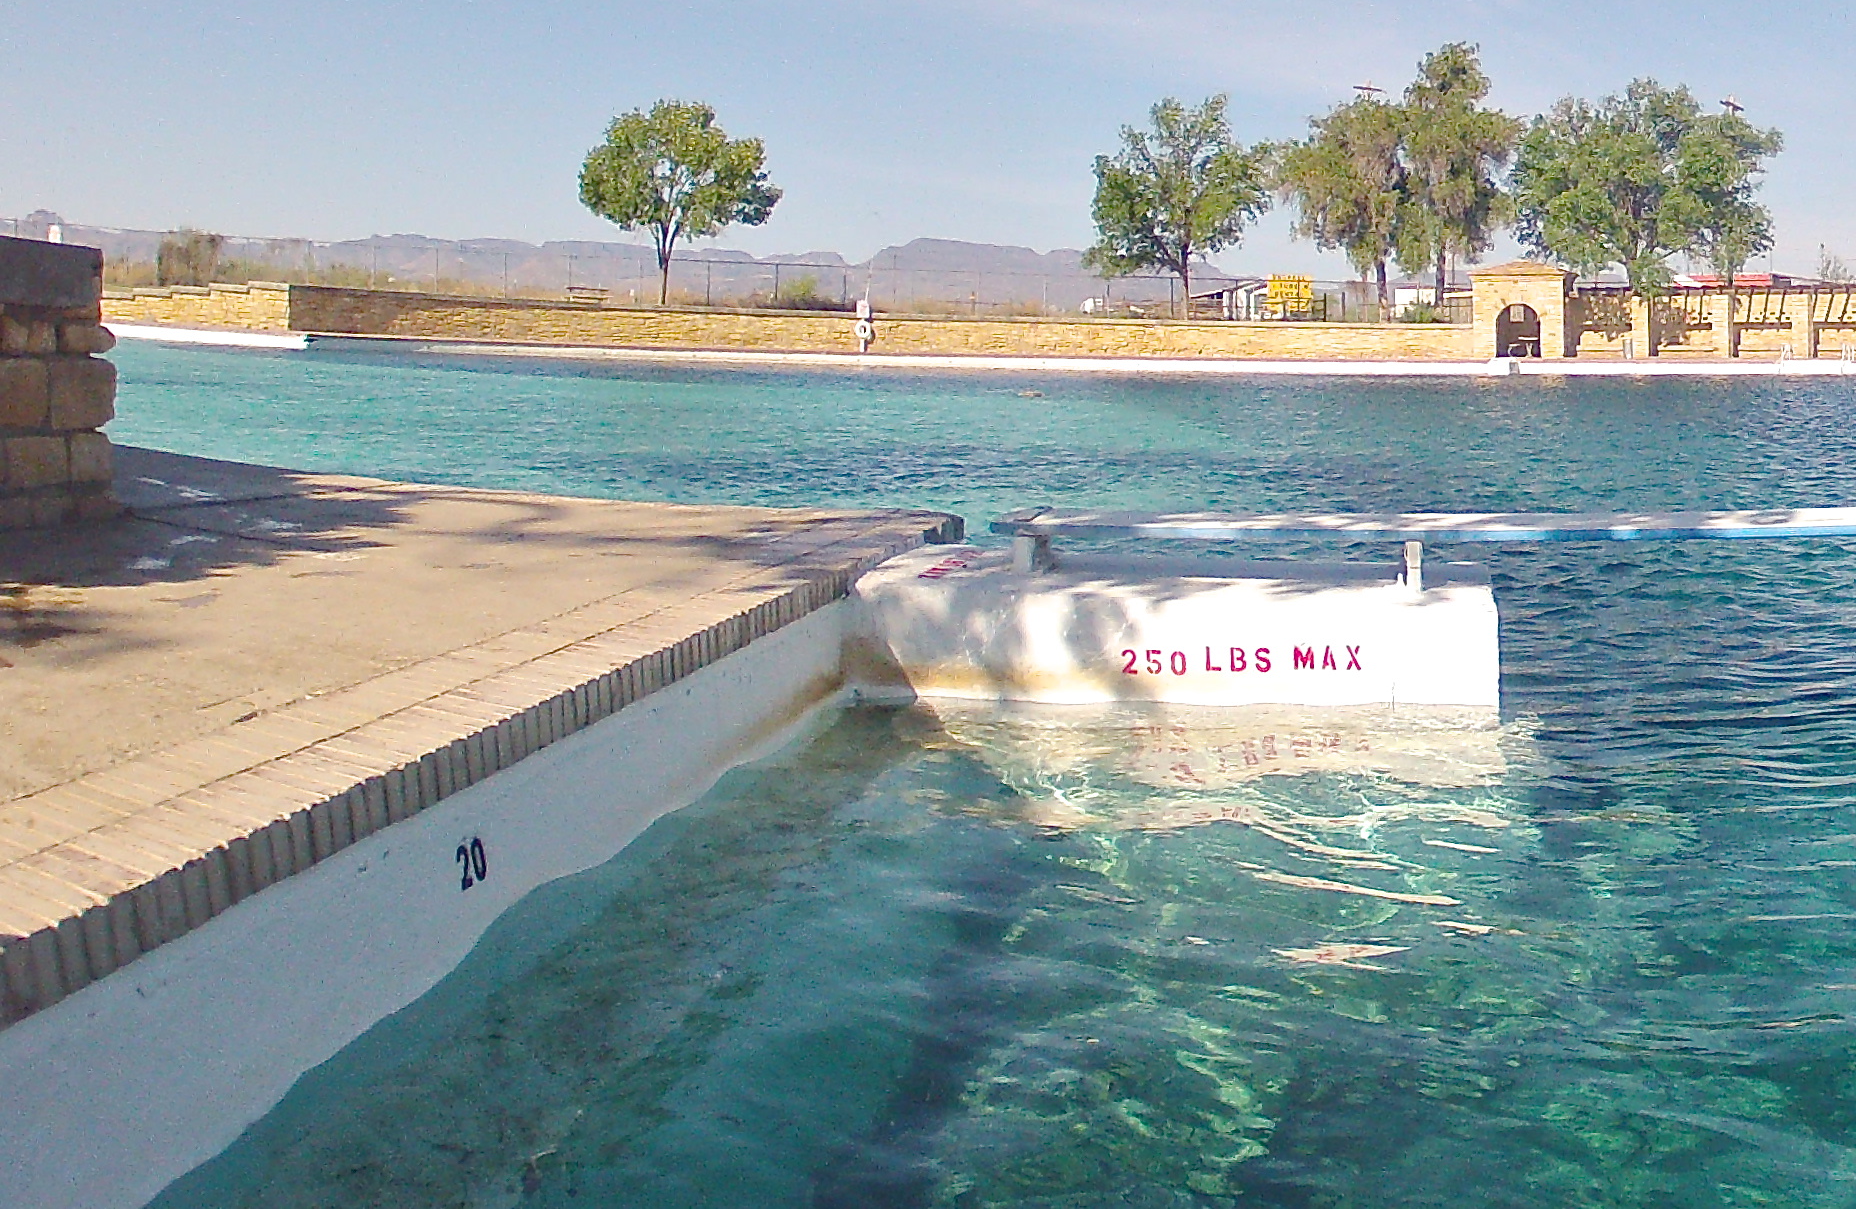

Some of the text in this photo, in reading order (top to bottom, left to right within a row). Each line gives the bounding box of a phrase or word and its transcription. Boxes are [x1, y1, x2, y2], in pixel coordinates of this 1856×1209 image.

[1120, 645, 1362, 676] 250 LBS MAX
[456, 837, 487, 891] 20
